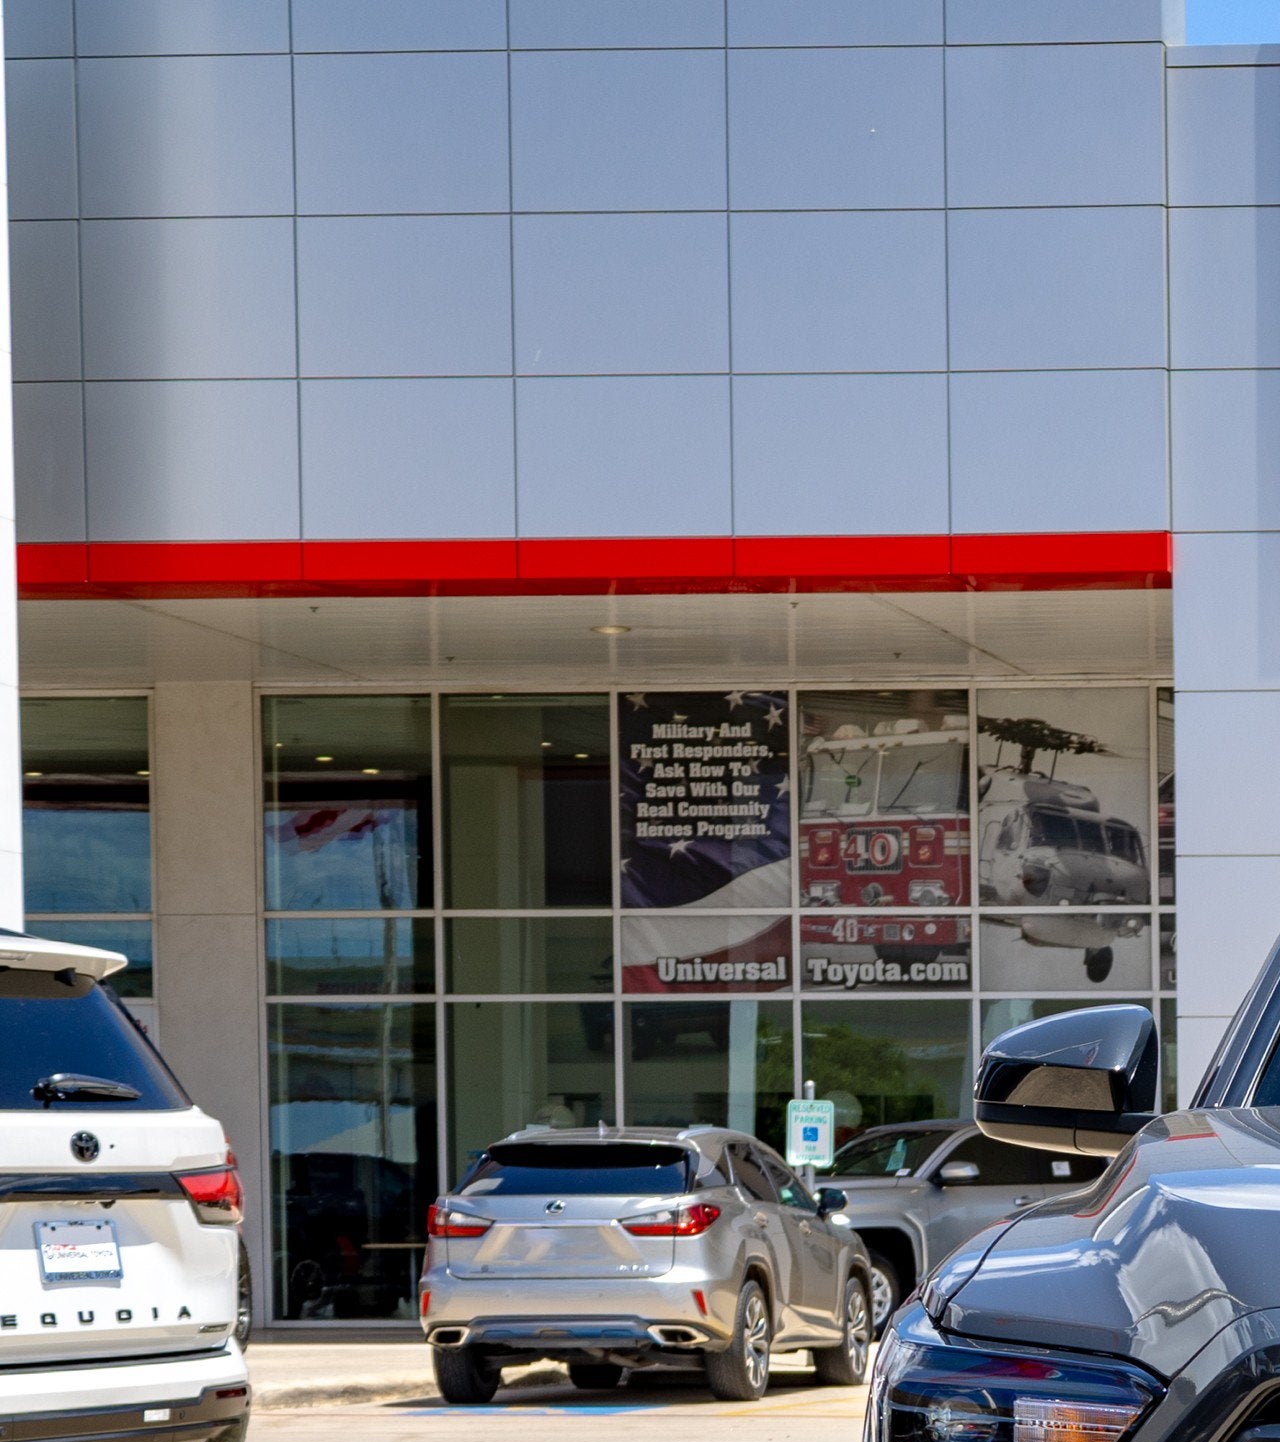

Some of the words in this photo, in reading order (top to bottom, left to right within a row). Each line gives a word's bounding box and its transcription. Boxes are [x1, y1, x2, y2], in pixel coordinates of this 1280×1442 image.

[652, 723, 715, 741] Military
[719, 722, 752, 738] And
[630, 744, 669, 759] First
[672, 741, 774, 761] Responders,
[653, 763, 686, 778] Ask
[689, 762, 726, 777] How
[729, 762, 751, 777] To
[645, 783, 686, 798] Save
[690, 782, 728, 797] With
[731, 781, 761, 796] Our
[637, 802, 674, 817] Real
[677, 801, 771, 819] Community
[636, 822, 693, 837] Heroes
[697, 821, 772, 840] Program.
[841, 832, 899, 868] 40
[656, 956, 788, 982] Universal
[807, 957, 969, 989] Toyota.com
[794, 1114, 827, 1125] PARKING
